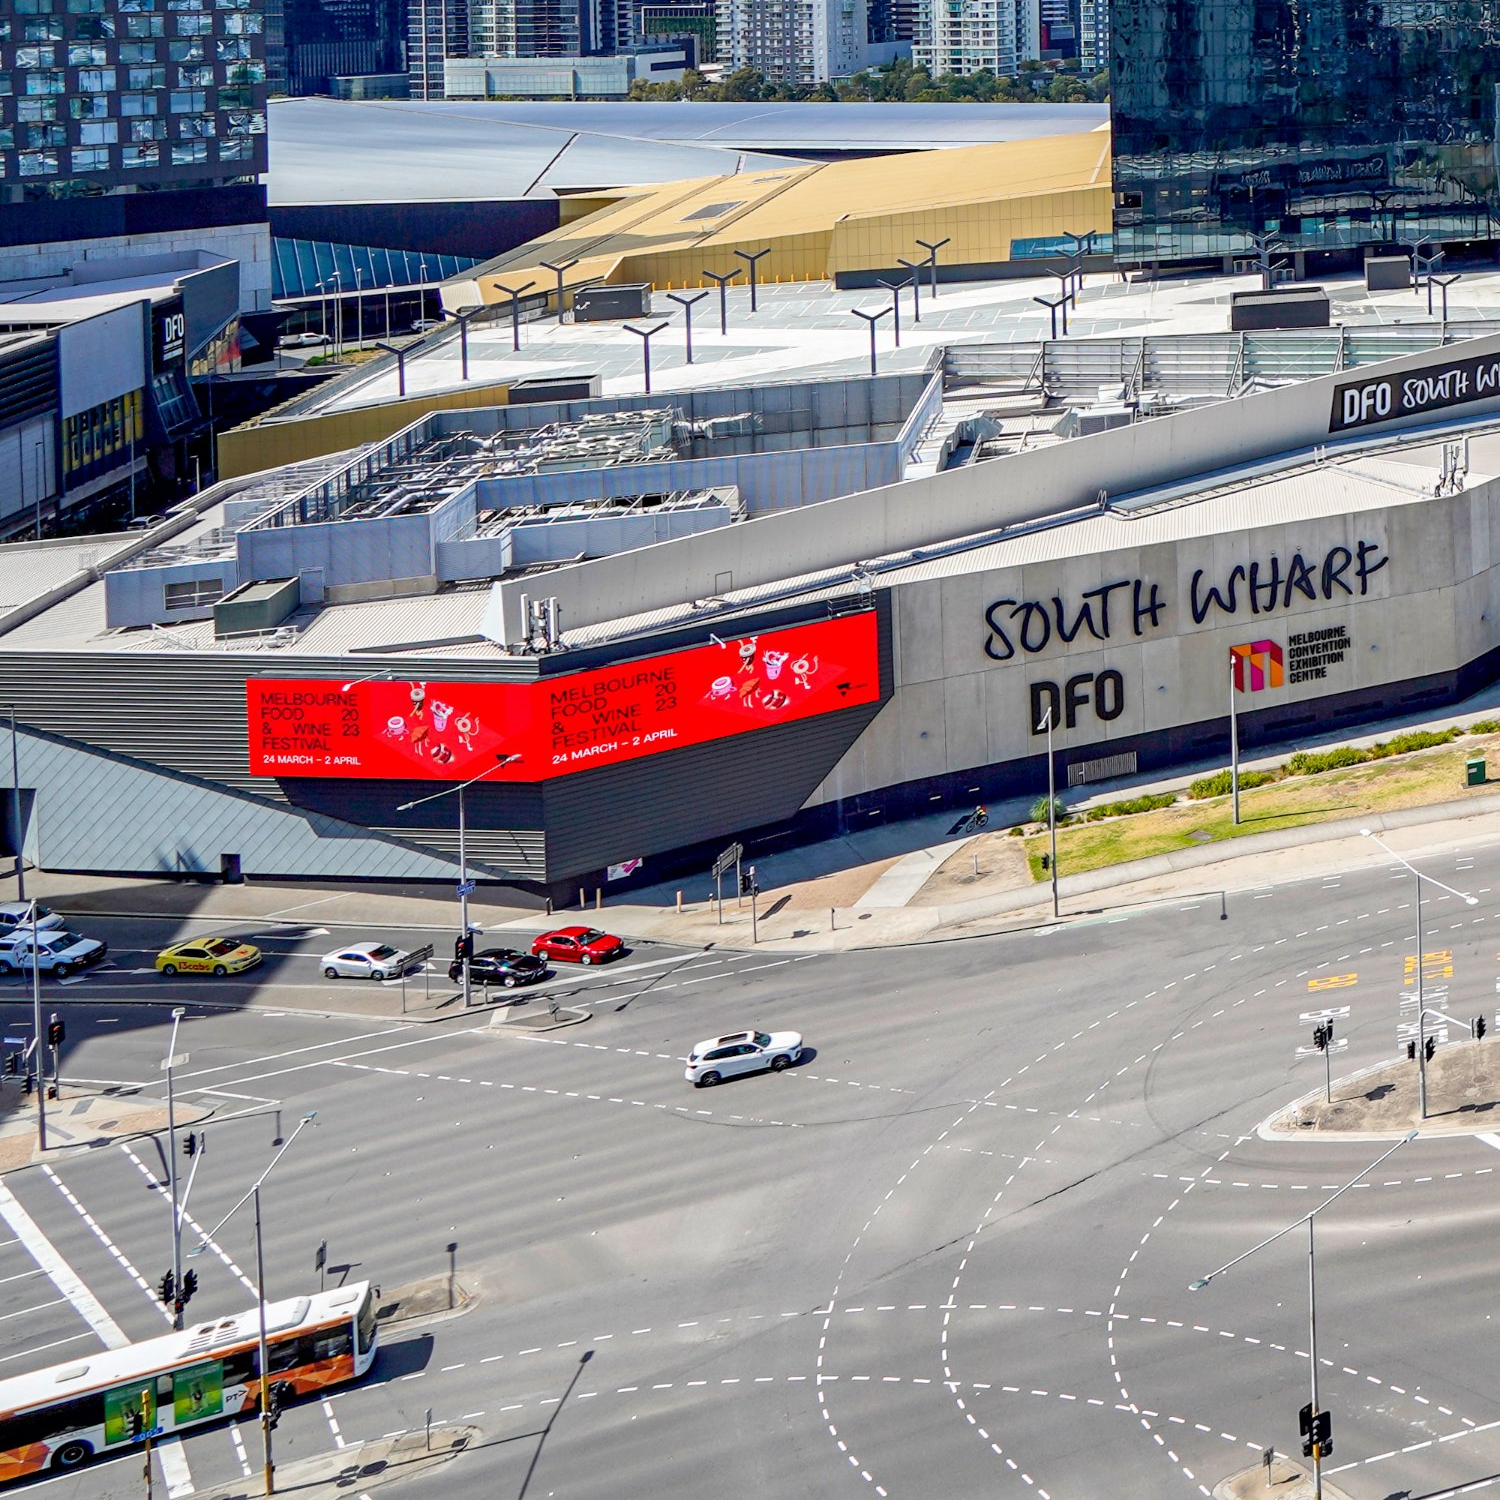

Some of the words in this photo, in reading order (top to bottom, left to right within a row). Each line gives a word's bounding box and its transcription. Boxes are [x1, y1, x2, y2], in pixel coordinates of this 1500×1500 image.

[165, 313, 184, 343] DFO
[1343, 381, 1392, 425] DFO
[1402, 369, 1470, 409] SOUTH
[984, 579, 1167, 661] SOUTH
[1190, 540, 1390, 625] WHARF
[1288, 625, 1346, 647] MELBOURNE
[1289, 637, 1351, 659] CONVENTION
[1289, 651, 1344, 672] EXHIBITION
[550, 667, 676, 705] MELBOURNE
[1289, 666, 1327, 684] CENTRE
[261, 692, 358, 707] MELBOURNE
[551, 697, 607, 720] FOOD
[655, 682, 677, 697] 20
[1030, 669, 1125, 736] DFO
[261, 707, 304, 720] FOOD
[341, 709, 359, 721] 20
[551, 721, 565, 735] &
[592, 703, 642, 725] WINE
[655, 696, 677, 712] 23
[262, 722, 273, 735] &
[293, 723, 332, 736] WINE
[342, 723, 360, 736] 23
[552, 720, 642, 750] FESTIVAL
[262, 737, 332, 750] FESTIVAL
[551, 754, 568, 765] 24
[571, 741, 618, 760] MARCH
[632, 737, 641, 746] 2
[644, 728, 678, 744] APRIL
[263, 754, 275, 764] 24
[277, 755, 314, 765] MARCH
[324, 756, 332, 764] 2
[333, 756, 361, 766] APRIL
[178, 961, 210, 971] 13cabs
